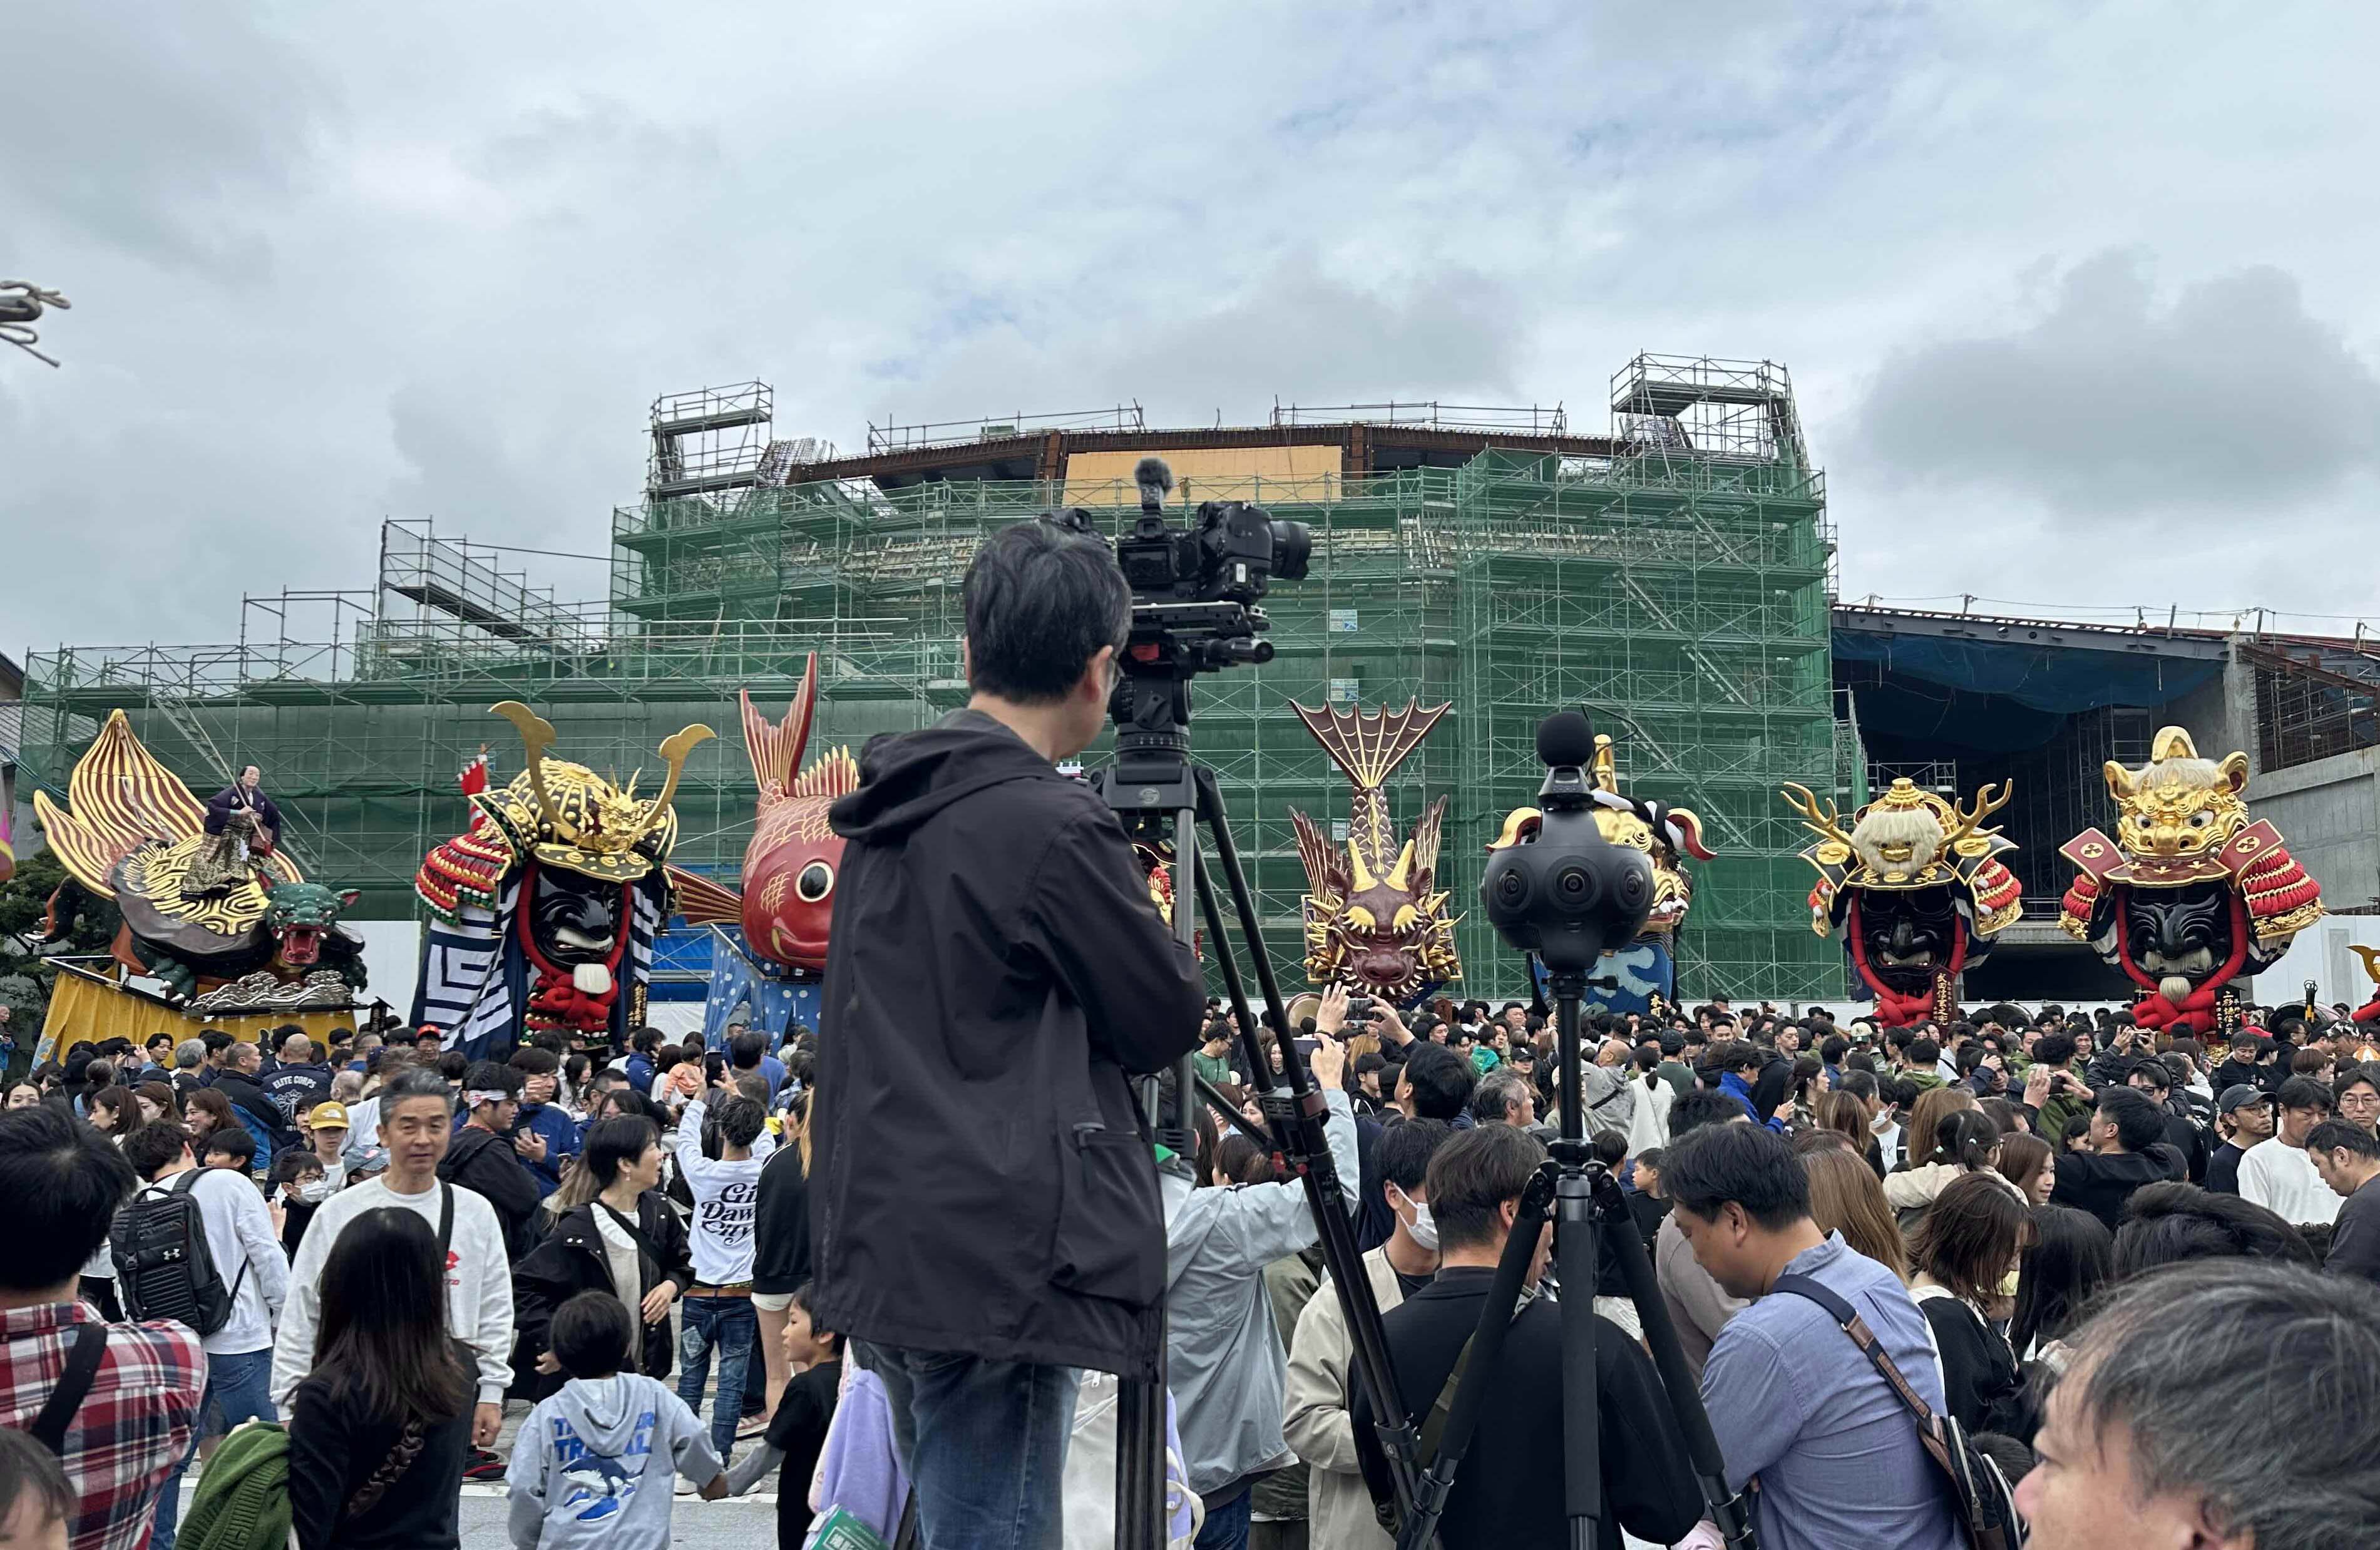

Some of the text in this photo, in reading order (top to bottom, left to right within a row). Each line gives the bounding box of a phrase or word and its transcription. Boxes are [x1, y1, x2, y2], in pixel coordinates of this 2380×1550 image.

[272, 1075, 317, 1089] ELITE CORPS
[721, 1183, 757, 1203] Gi
[701, 1220, 753, 1246] City
